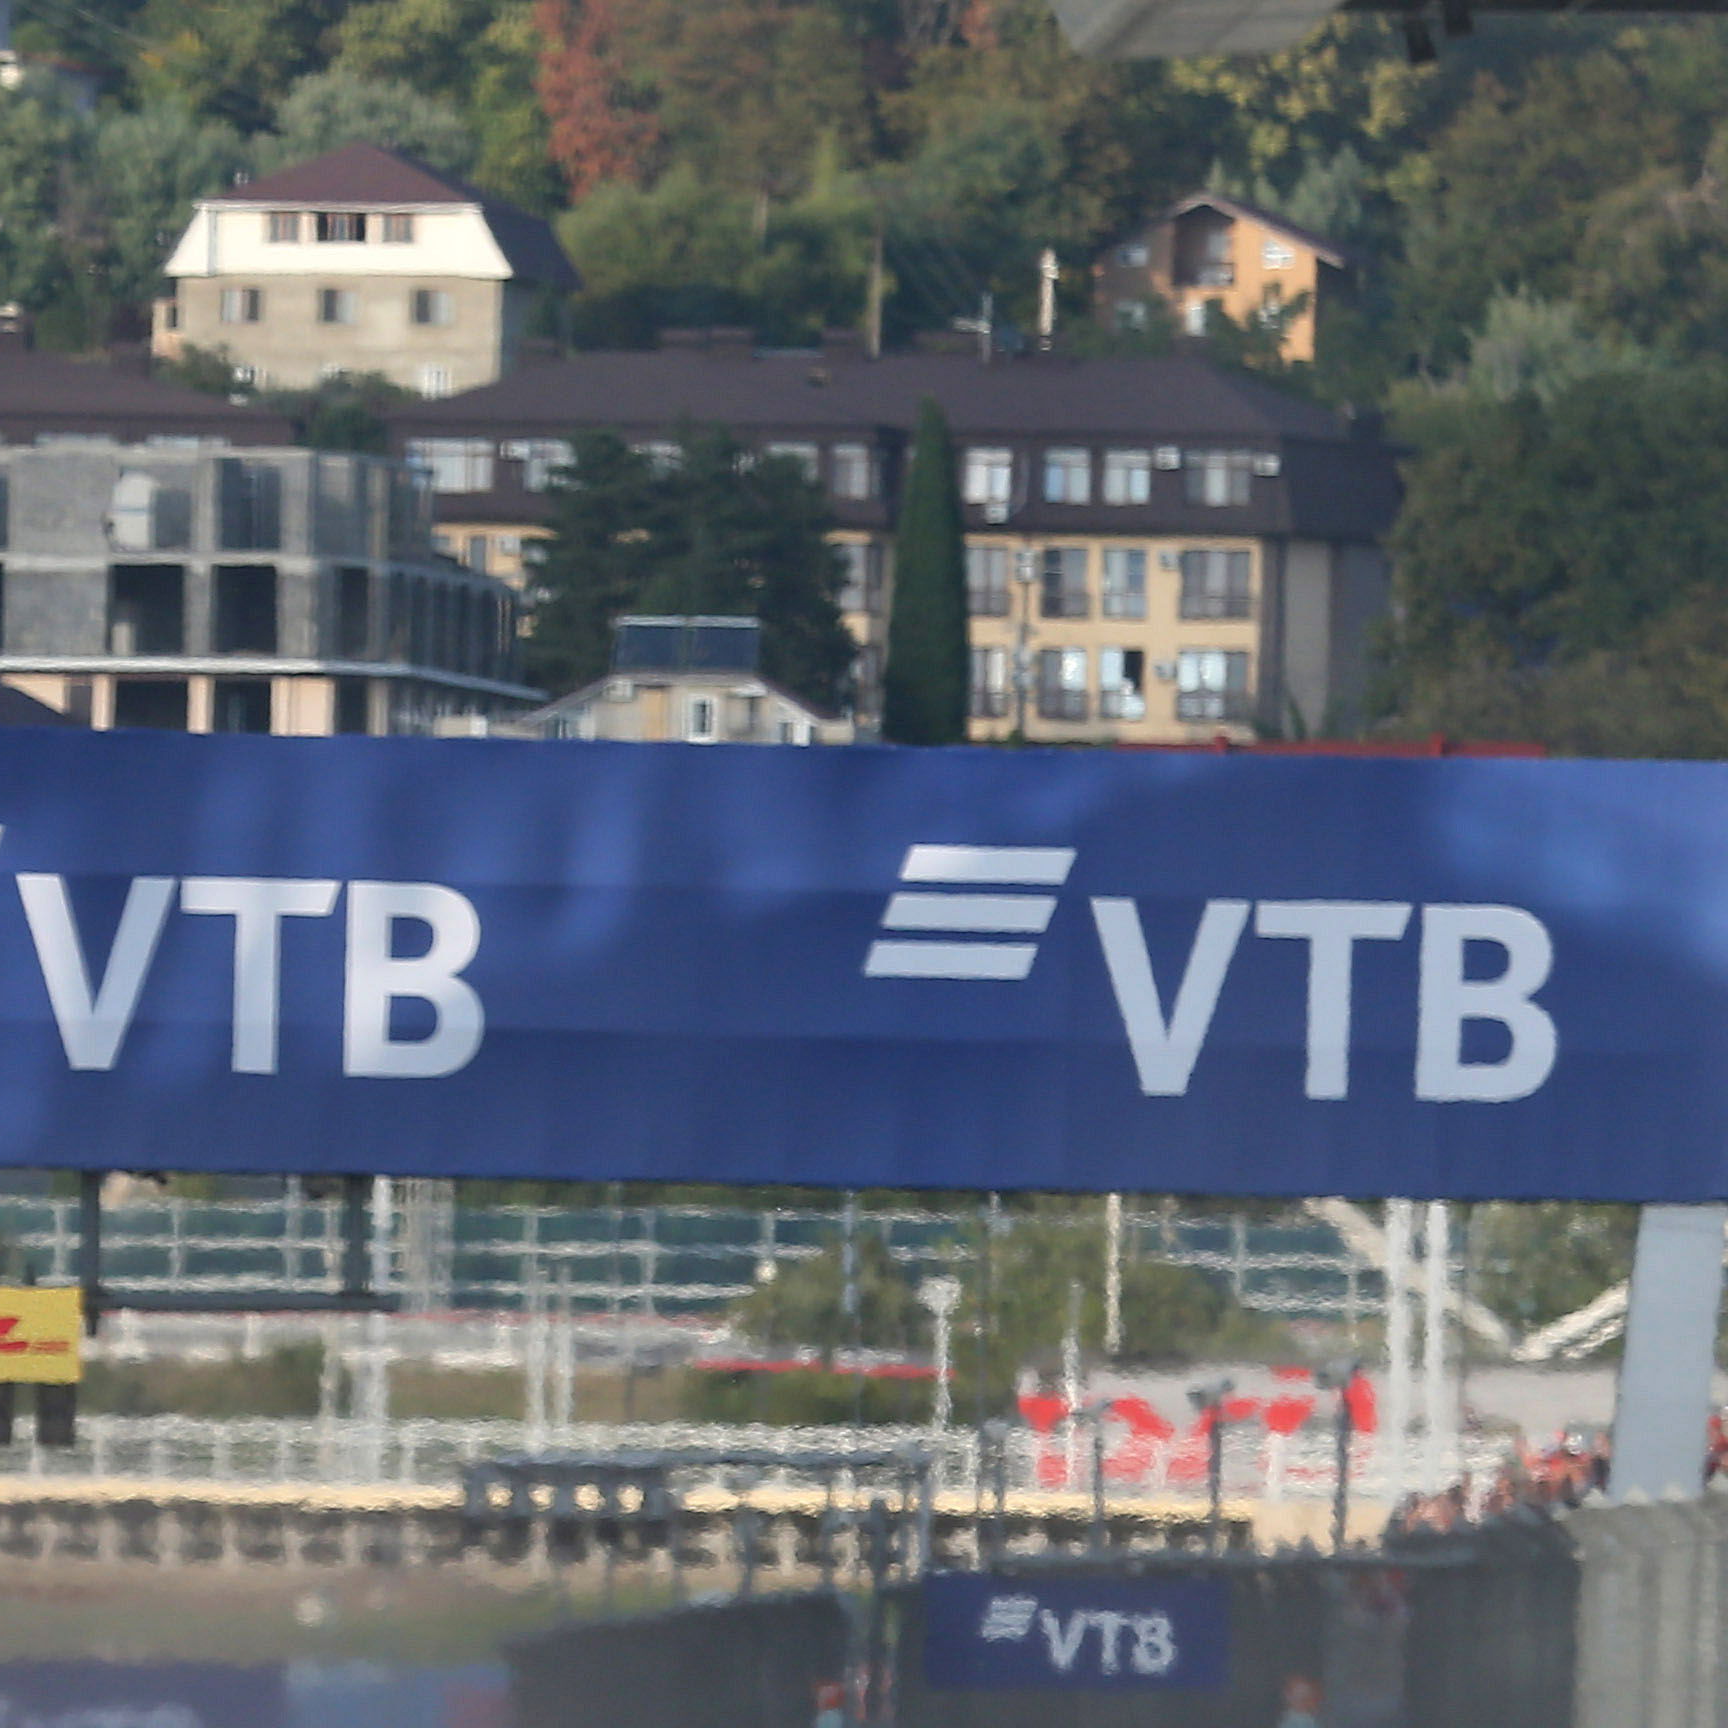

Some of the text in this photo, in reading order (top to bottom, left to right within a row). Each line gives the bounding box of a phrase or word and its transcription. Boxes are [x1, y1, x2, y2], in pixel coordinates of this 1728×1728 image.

[16, 873, 482, 1077] VTB
[1092, 897, 1557, 1102] VTB
[1039, 1609, 1177, 1675] VTB
